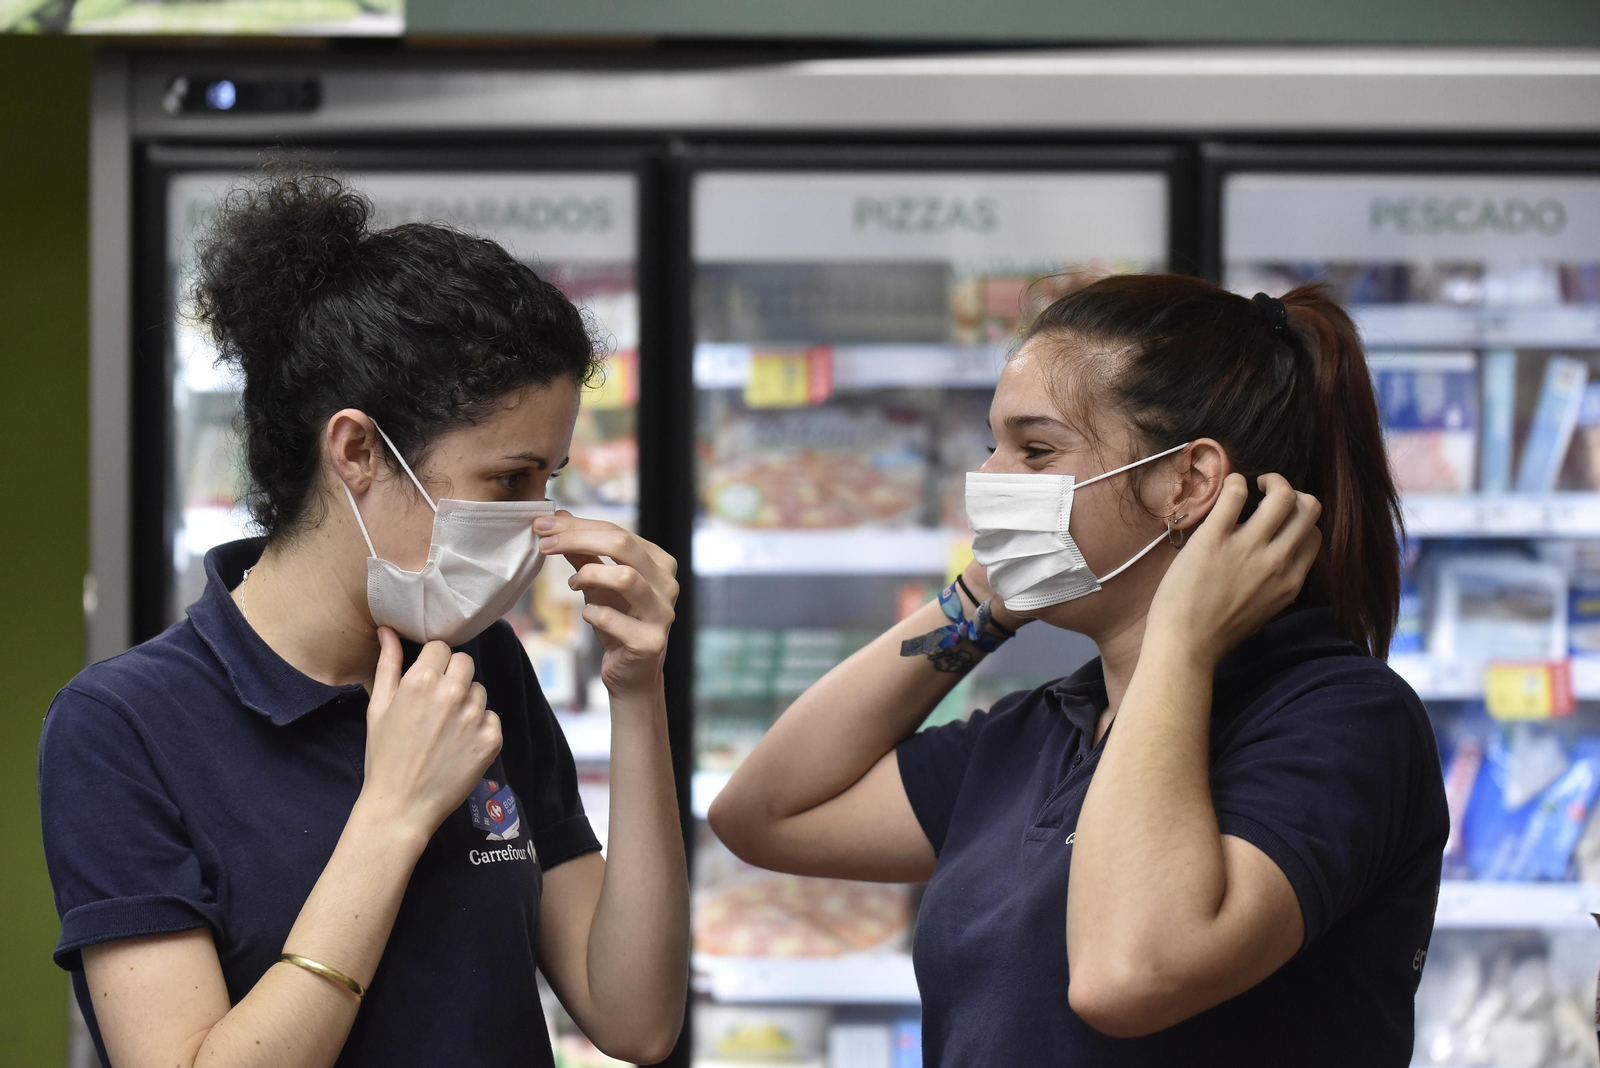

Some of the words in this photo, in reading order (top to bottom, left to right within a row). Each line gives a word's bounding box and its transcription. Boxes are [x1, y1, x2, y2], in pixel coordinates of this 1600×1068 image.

[853, 196, 998, 233] PIZZAS
[1369, 198, 1566, 235] PESCADO
[471, 804, 480, 823] PASS
[469, 844, 527, 865] Carrefour
